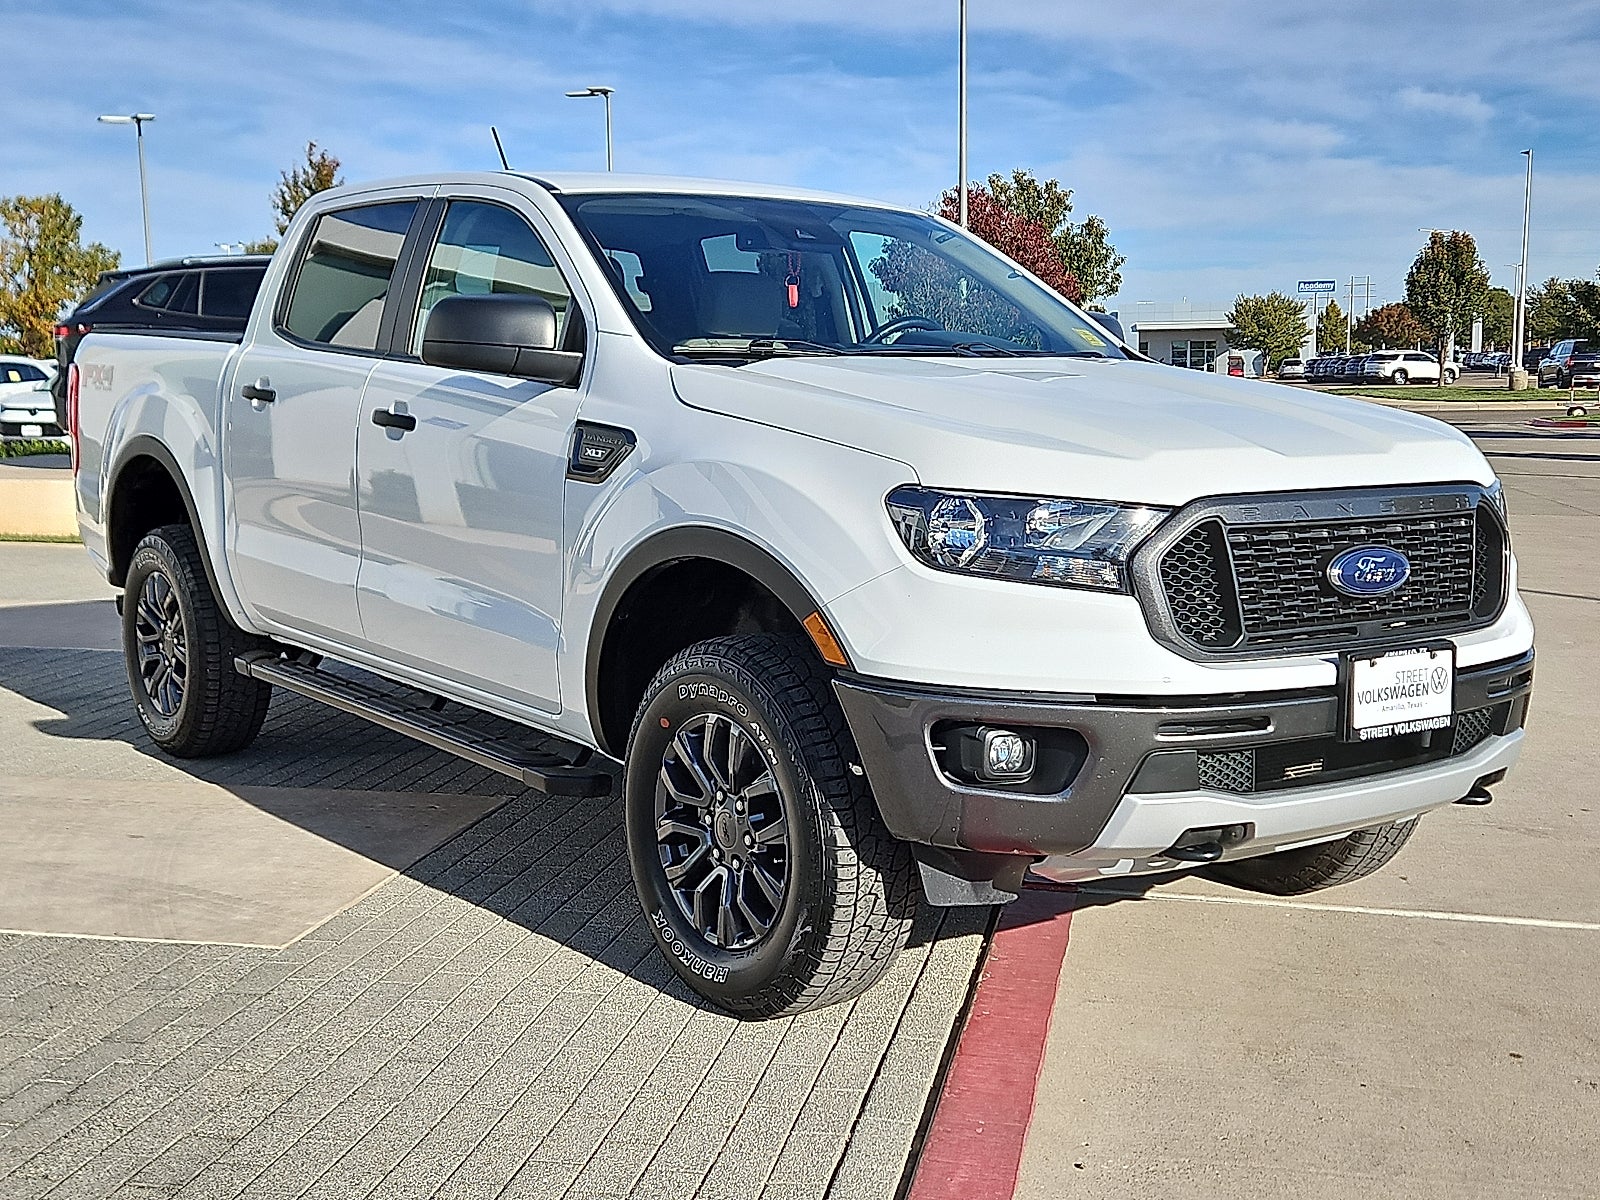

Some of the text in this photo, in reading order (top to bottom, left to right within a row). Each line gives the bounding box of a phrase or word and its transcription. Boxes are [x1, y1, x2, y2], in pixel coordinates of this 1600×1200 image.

[1299, 281, 1335, 291] Academy
[585, 447, 606, 458] XLT
[1355, 556, 1397, 584] Ford
[1395, 668, 1429, 685] STREET
[1357, 682, 1430, 705] VOLKSWAGEN
[1359, 716, 1451, 741] STREET VOLKSWAGEN
